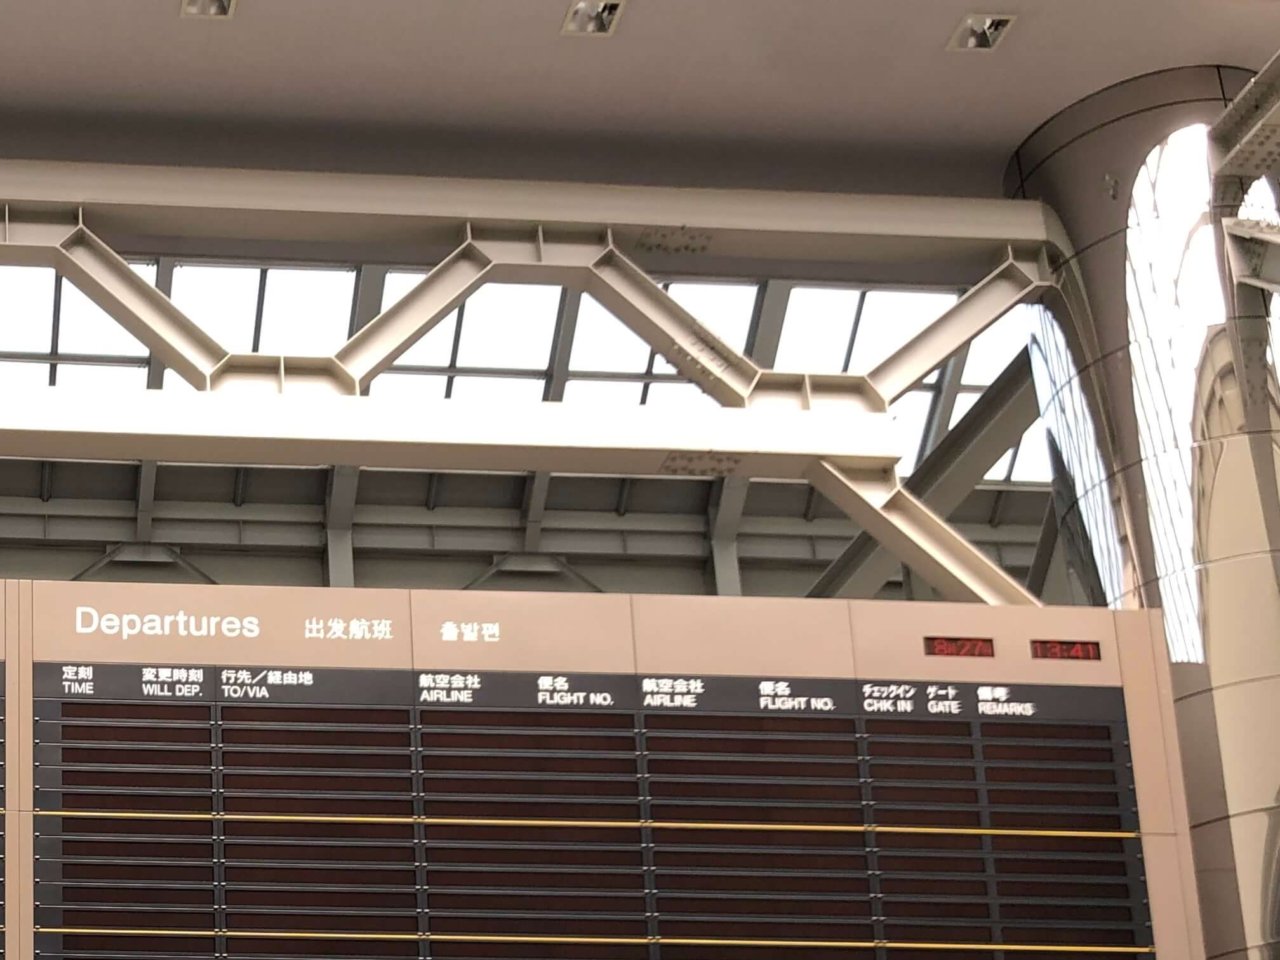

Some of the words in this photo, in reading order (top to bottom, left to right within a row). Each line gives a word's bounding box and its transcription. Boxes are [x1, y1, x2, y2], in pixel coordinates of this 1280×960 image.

[74, 605, 261, 640] Departures
[304, 617, 393, 641] 出发航班
[439, 619, 501, 642] 출발편
[62, 665, 94, 680] 定刻
[141, 667, 204, 683] 変更時刻
[419, 673, 481, 690] 航空会社
[62, 681, 95, 695] TIME
[142, 683, 173, 697] WILL
[175, 684, 203, 697] DEP.
[221, 684, 270, 699] TO/VIA
[420, 689, 474, 703] AIRLINE
[643, 694, 698, 708] AIRLINE
[927, 700, 962, 715] GATE
